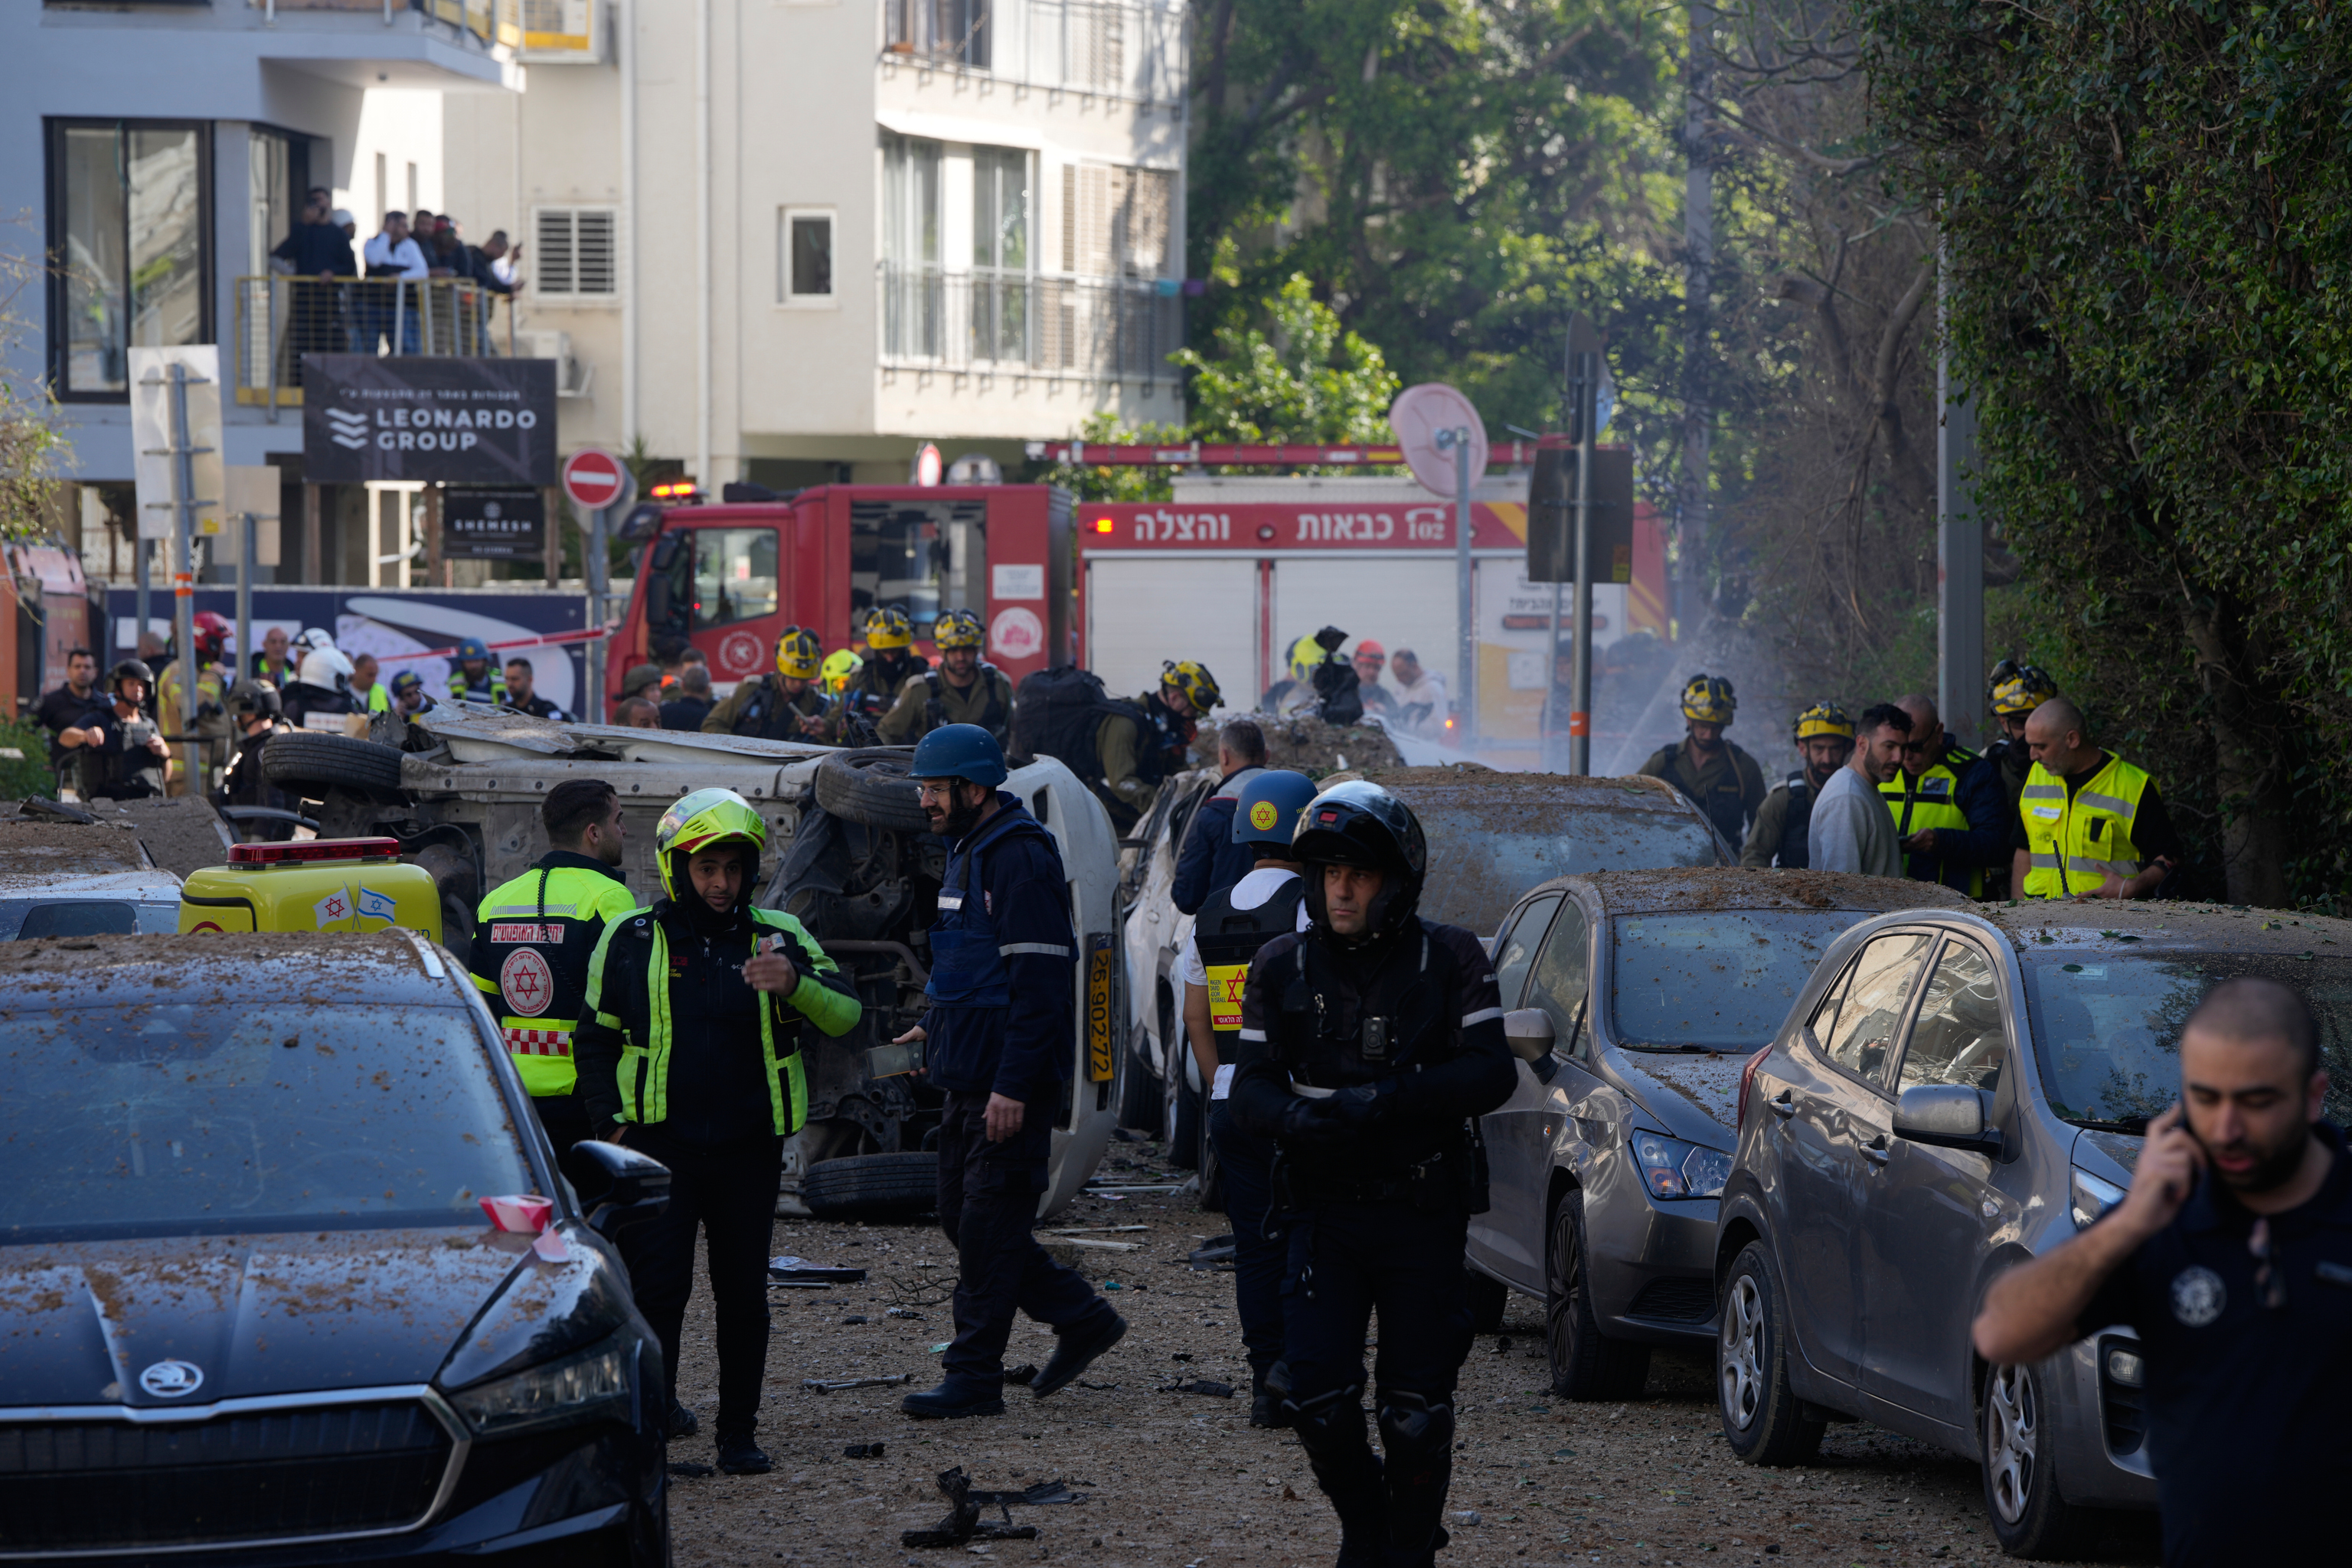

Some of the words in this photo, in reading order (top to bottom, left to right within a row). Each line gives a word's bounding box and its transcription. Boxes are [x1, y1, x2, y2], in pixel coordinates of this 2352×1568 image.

[377, 408, 537, 429] LEONARDO
[377, 431, 478, 451] GROUP
[454, 518, 532, 532] SHEMESH
[1135, 508, 1230, 541] והצלה
[1296, 512, 1394, 541] כבאות
[1407, 521, 1446, 541] 102
[492, 926, 534, 941] האופנועים
[506, 985, 515, 1002] MAGEN
[514, 1001, 527, 1010] DAVID
